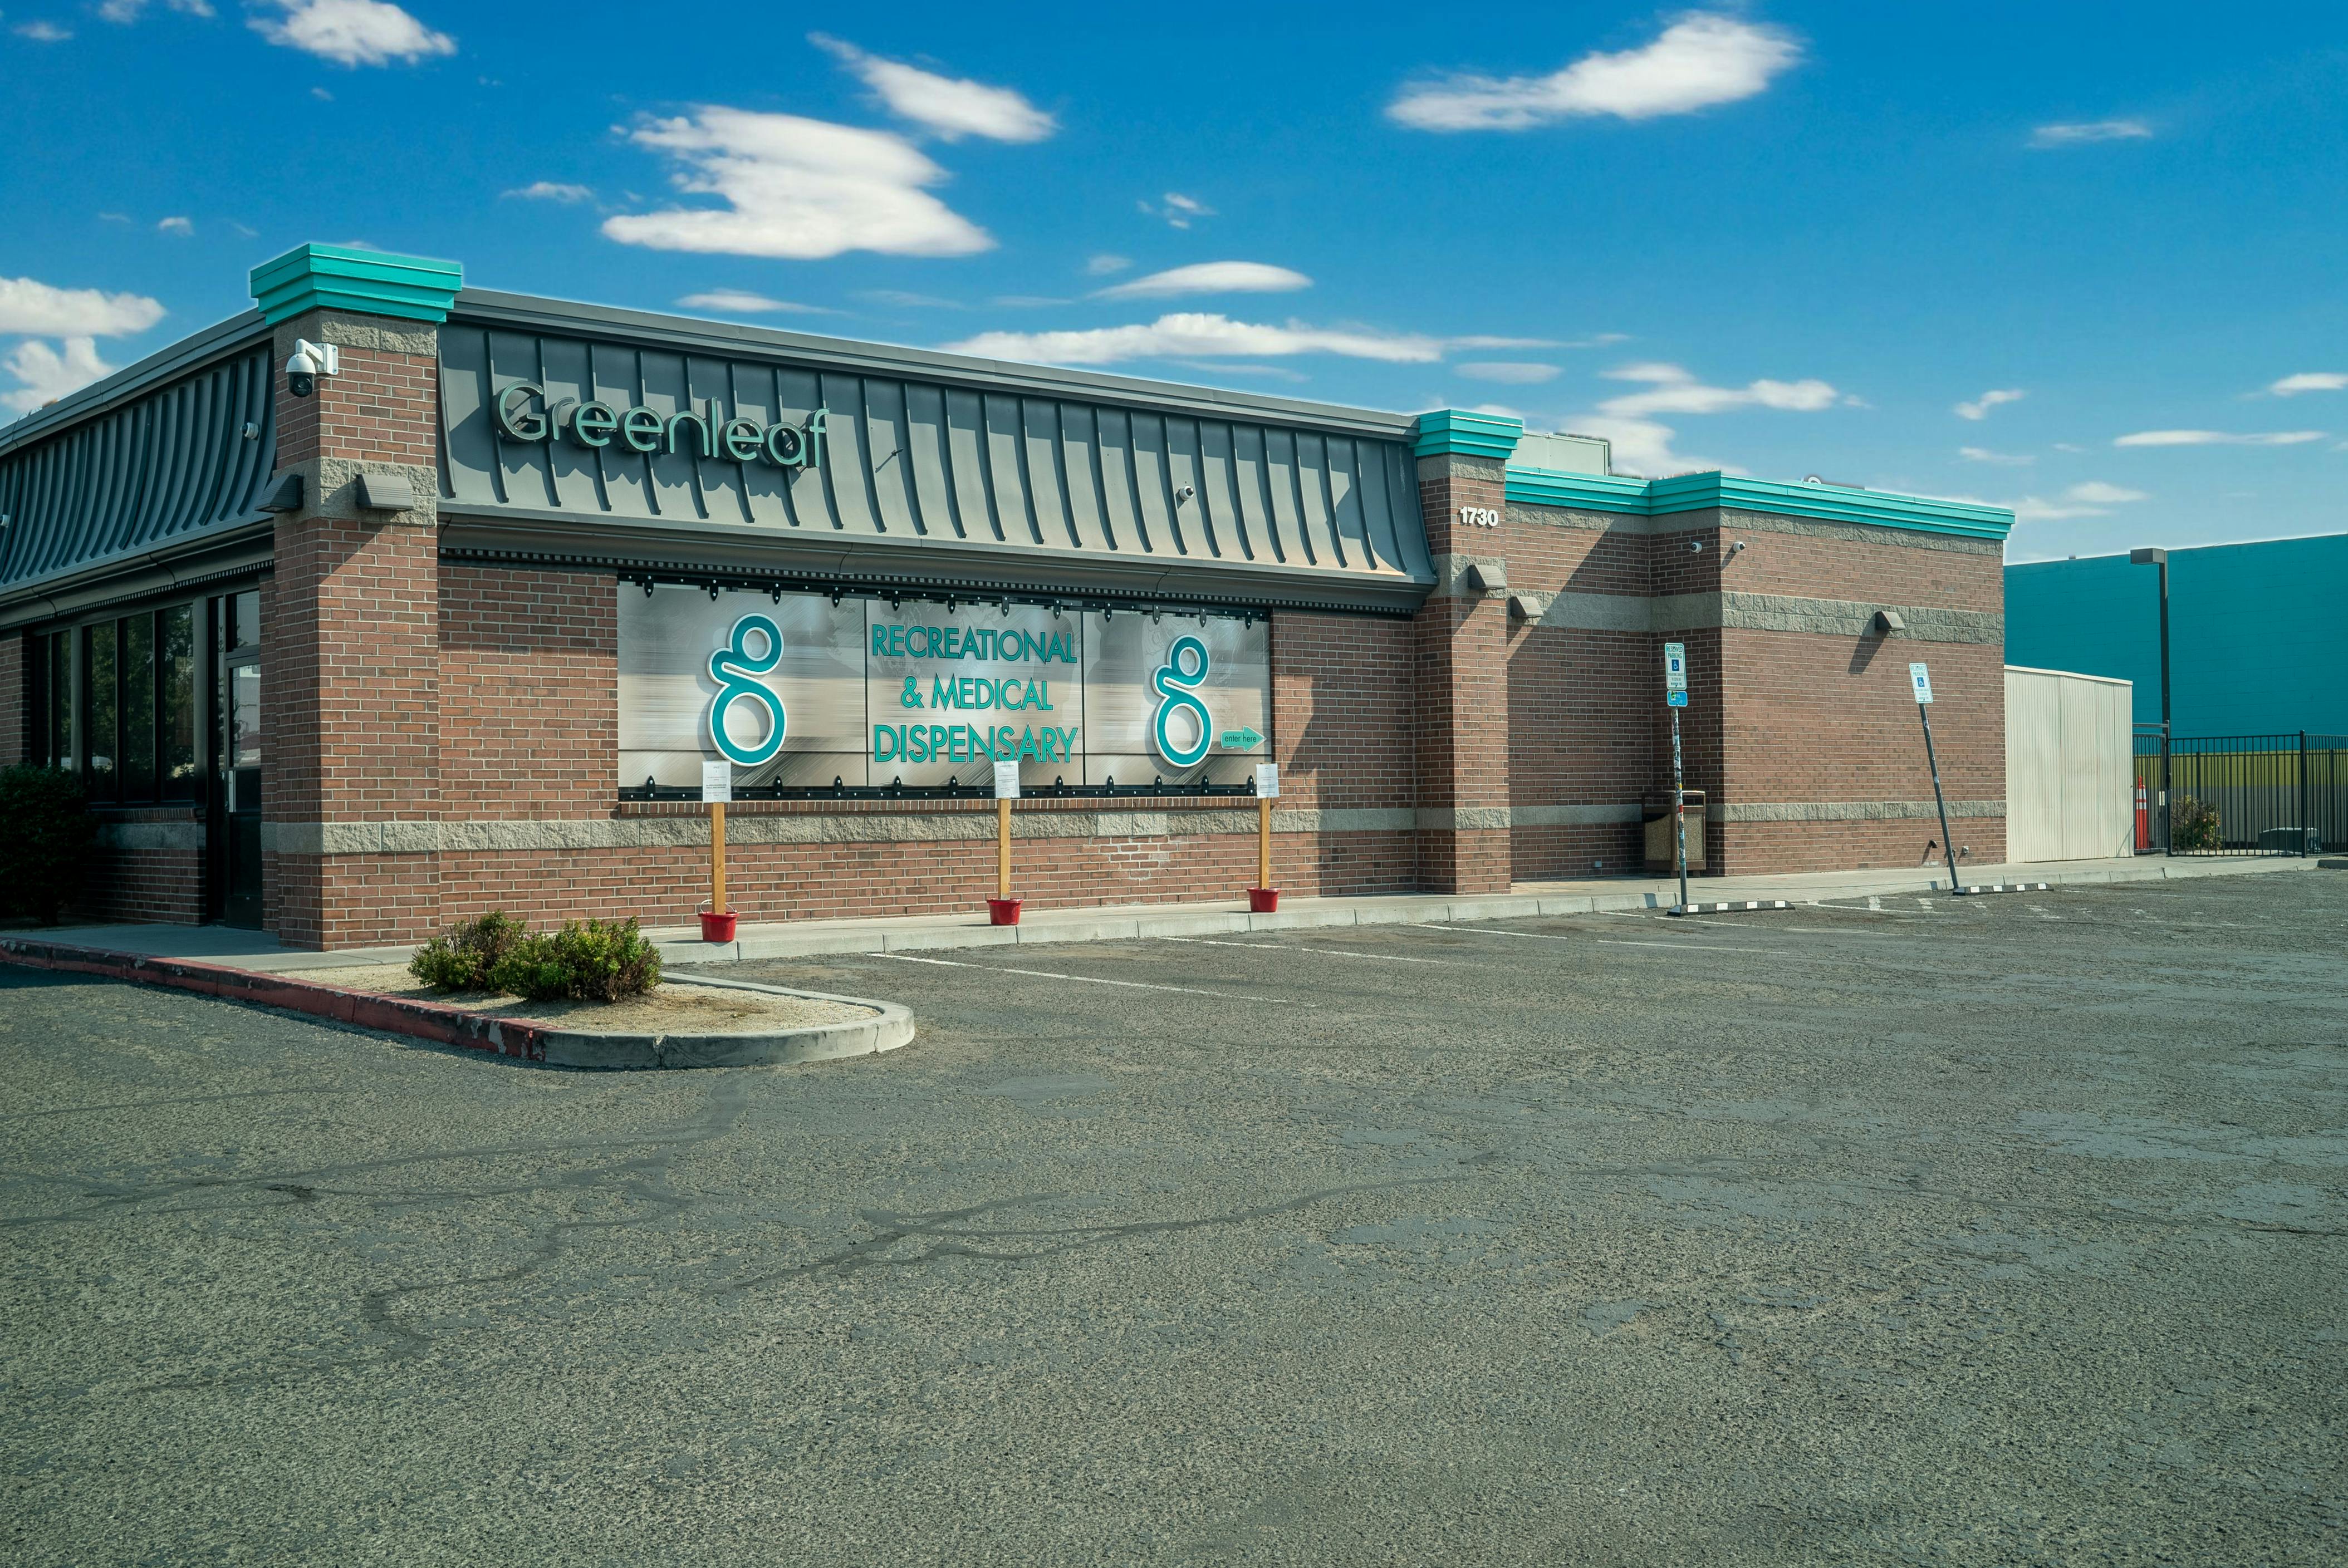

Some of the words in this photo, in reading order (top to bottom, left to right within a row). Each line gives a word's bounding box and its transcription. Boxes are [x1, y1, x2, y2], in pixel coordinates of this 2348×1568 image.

[493, 380, 830, 468] Greenleaf
[1460, 506, 1499, 527] 1730
[872, 624, 1078, 665] RECREATIONAL
[901, 675, 925, 709] &
[931, 673, 1054, 711] MEDICAL
[874, 722, 1079, 764] DISPENSARY
[1224, 734, 1241, 743] enter
[1242, 733, 1257, 743] here
